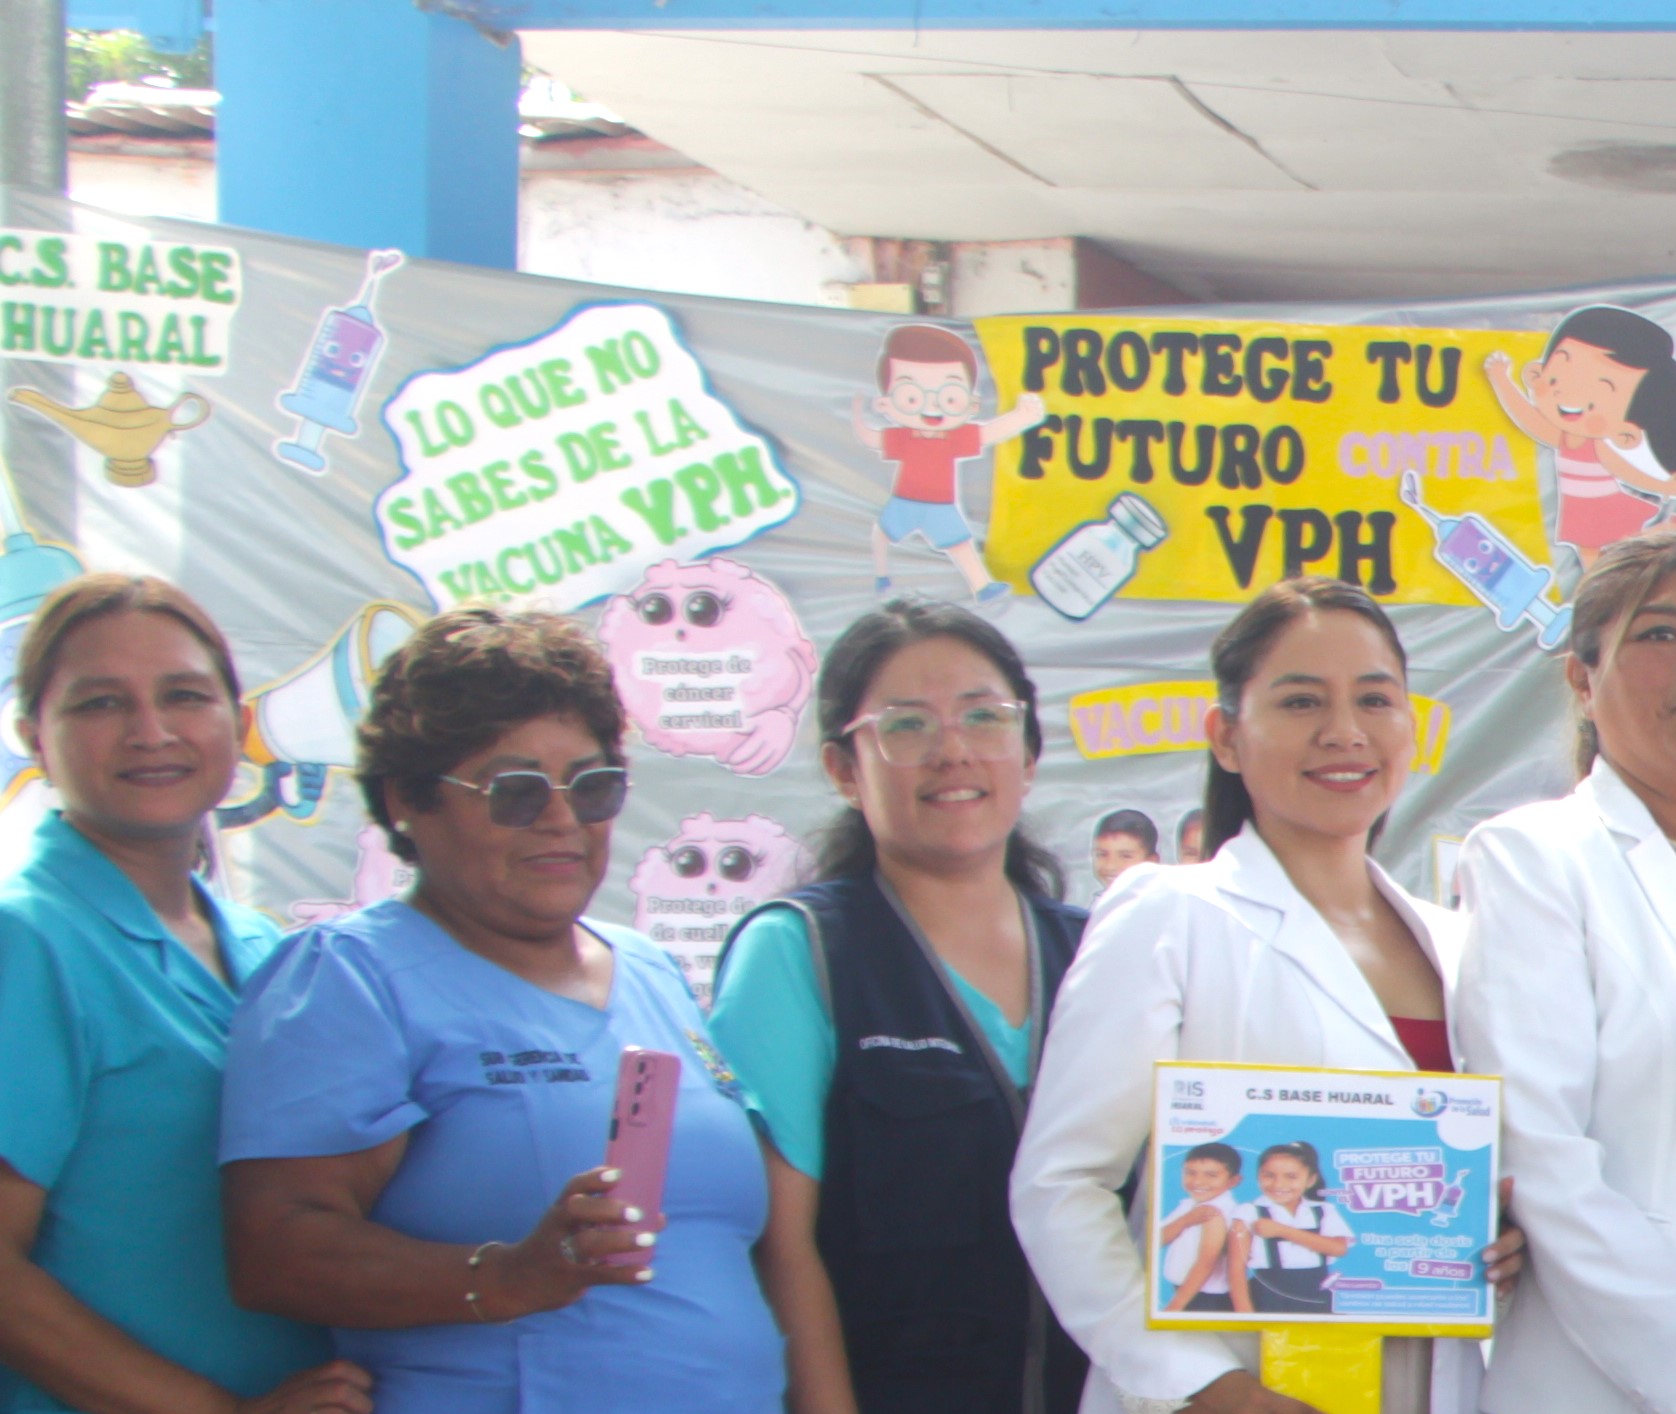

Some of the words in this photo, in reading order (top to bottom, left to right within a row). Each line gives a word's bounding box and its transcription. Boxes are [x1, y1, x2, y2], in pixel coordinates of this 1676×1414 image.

[0, 235, 76, 288] C.S.
[97, 241, 235, 304] BASE
[1, 301, 222, 367] HUARAL
[1021, 326, 1333, 404] PROTEGE
[1366, 340, 1462, 406] TU
[408, 402, 475, 458] LO
[482, 358, 586, 429] QUE
[587, 330, 662, 395] NO
[387, 450, 560, 550] SABES
[568, 430, 632, 481] DE
[645, 398, 709, 457] LA
[1017, 414, 1304, 491] FUTURO
[1339, 432, 1517, 482] CONTRA
[437, 513, 633, 604] VACUNA
[1205, 504, 1397, 595] VPH
[642, 657, 722, 677] Protege
[726, 655, 751, 674] de
[659, 711, 743, 730] cervical
[1278, 1089, 1322, 1102] BASE
[1327, 1091, 1394, 1105] HUARAL
[1339, 1151, 1412, 1164] PROTEGE
[1353, 1165, 1429, 1180] FUTURO
[1353, 1182, 1435, 1209] VPH
[1417, 1263, 1430, 1274] 9
[1431, 1264, 1466, 1278] años
